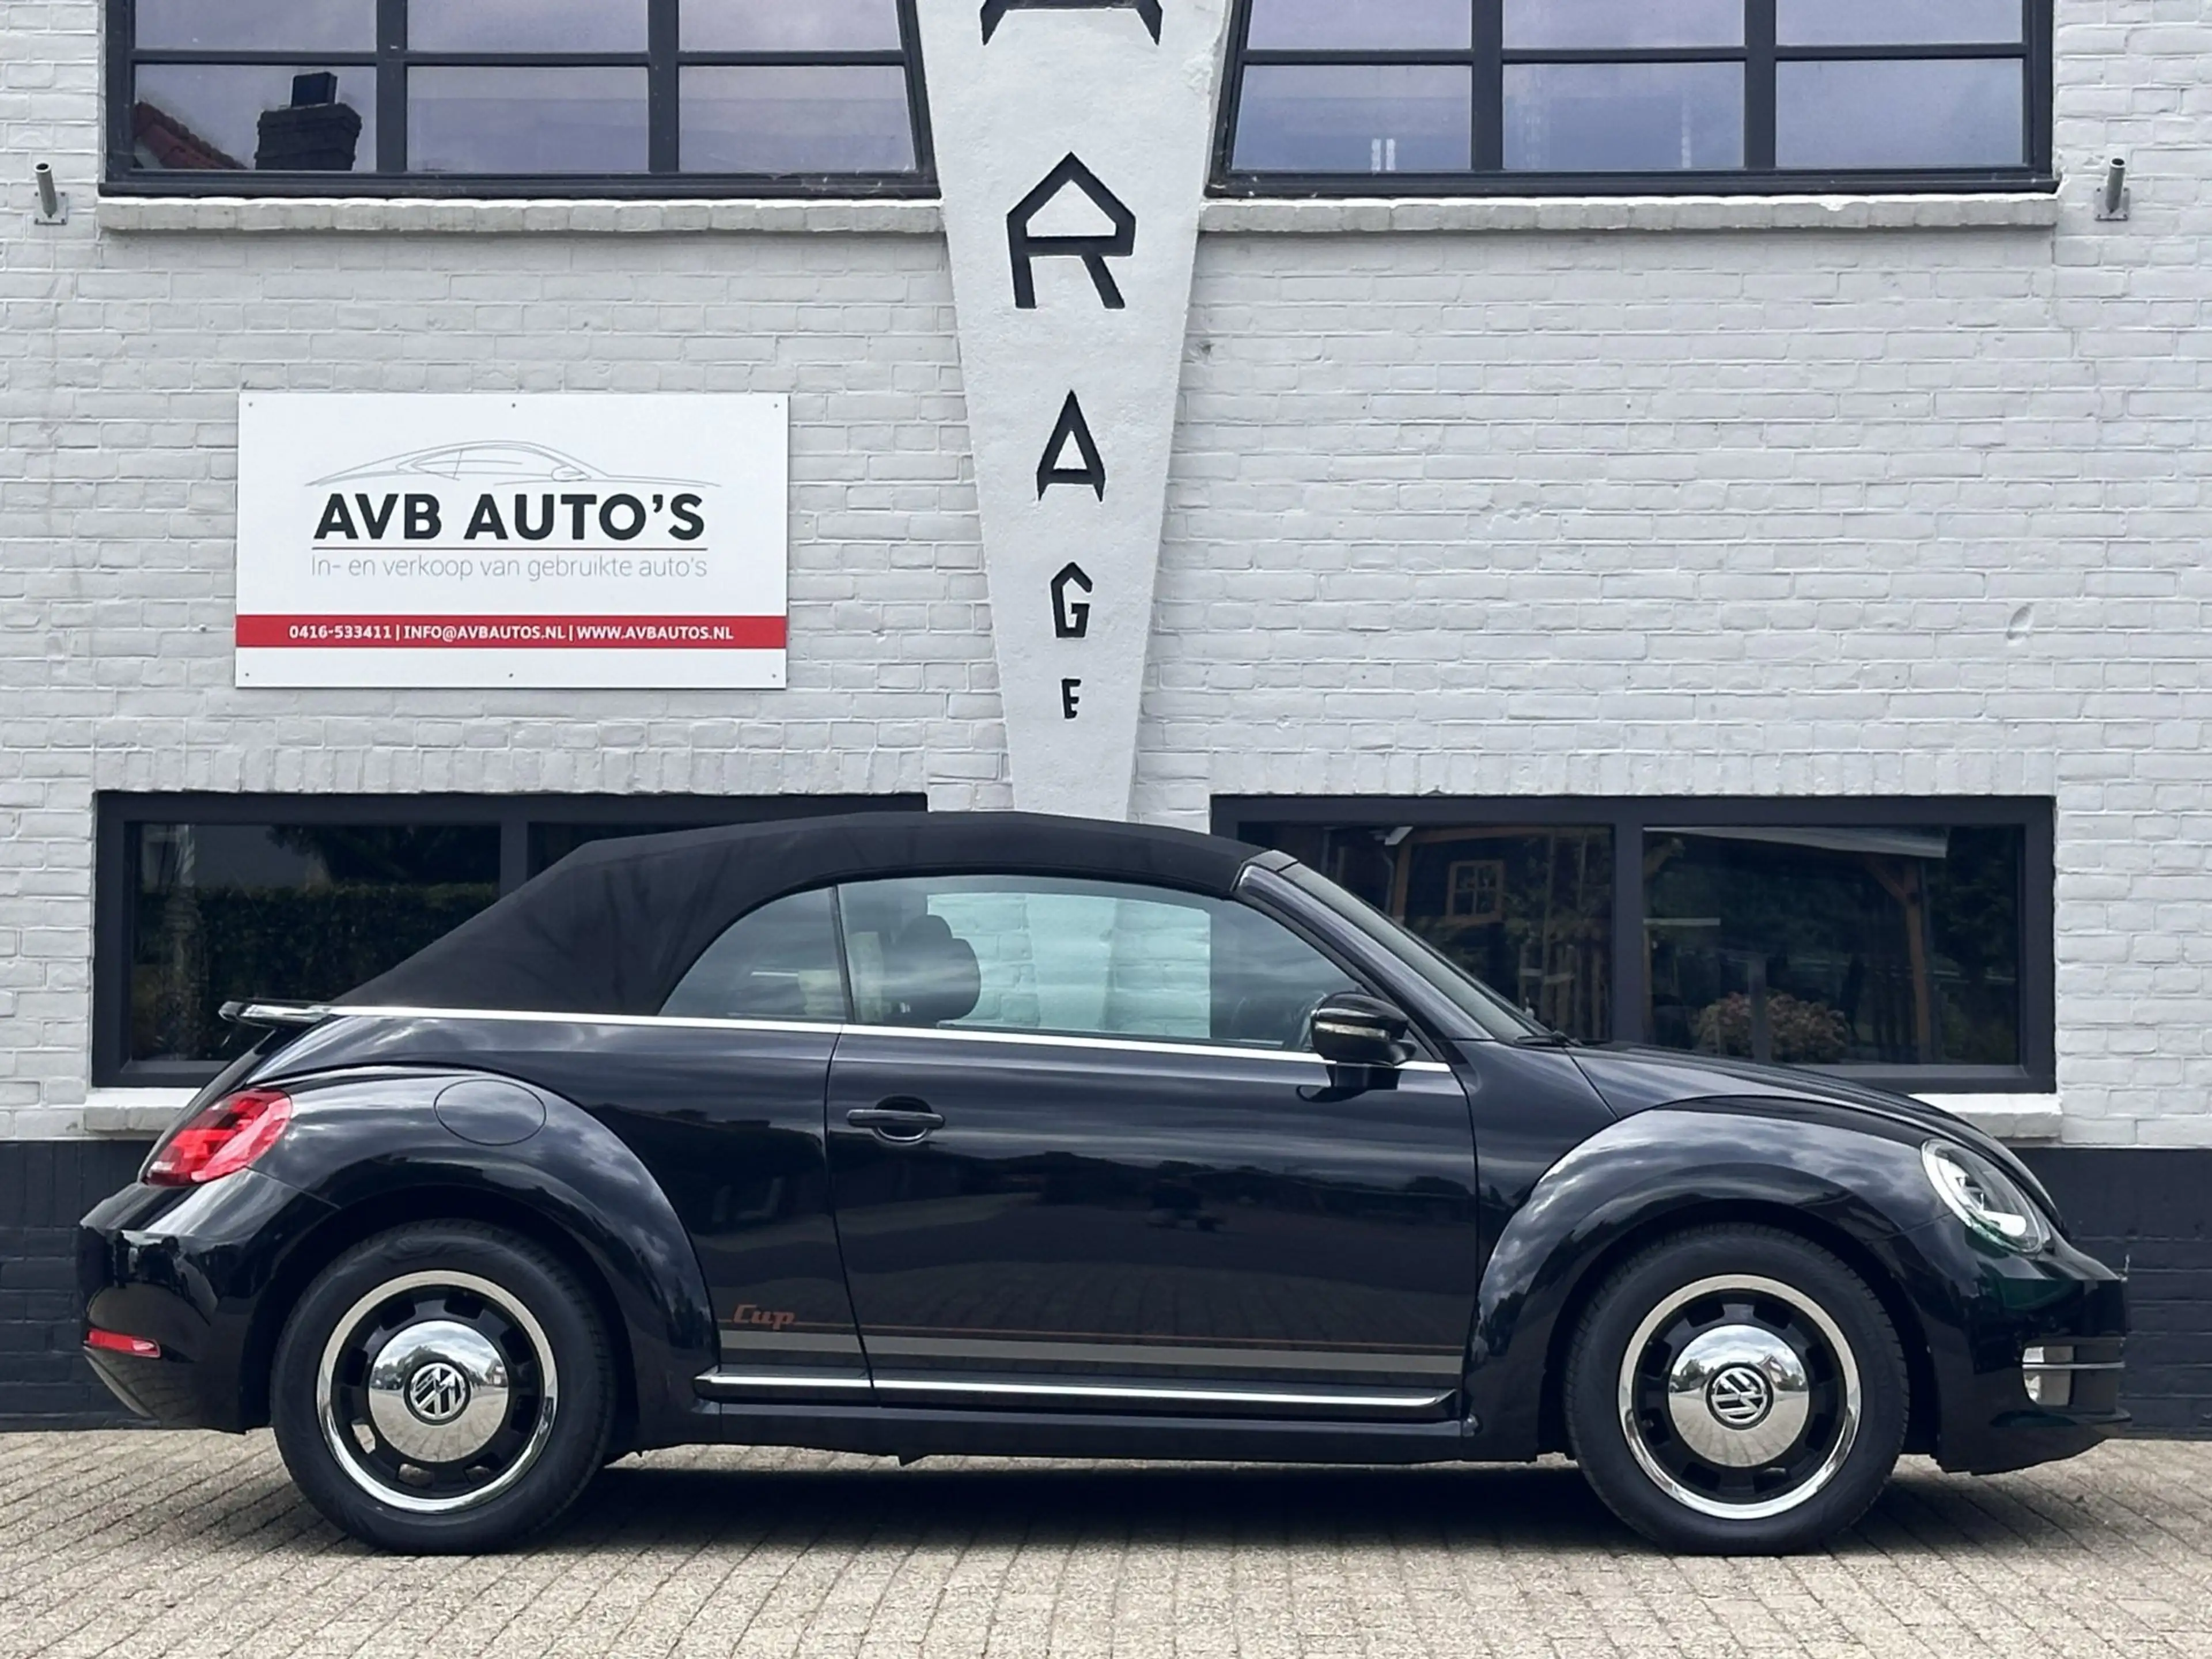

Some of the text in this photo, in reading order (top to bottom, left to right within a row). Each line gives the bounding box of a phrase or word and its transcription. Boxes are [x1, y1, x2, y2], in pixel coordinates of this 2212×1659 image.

[980, 0, 1163, 719] RAGE
[314, 494, 704, 540] AVB AUTO'S
[312, 555, 707, 581] In- en verkoop van gebruikte auto's
[289, 626, 733, 642] 0416-533411 INFO@AVBAUTOS.NL WWW.AVBAUTOS.NL
[733, 1304, 796, 1331] Cup
